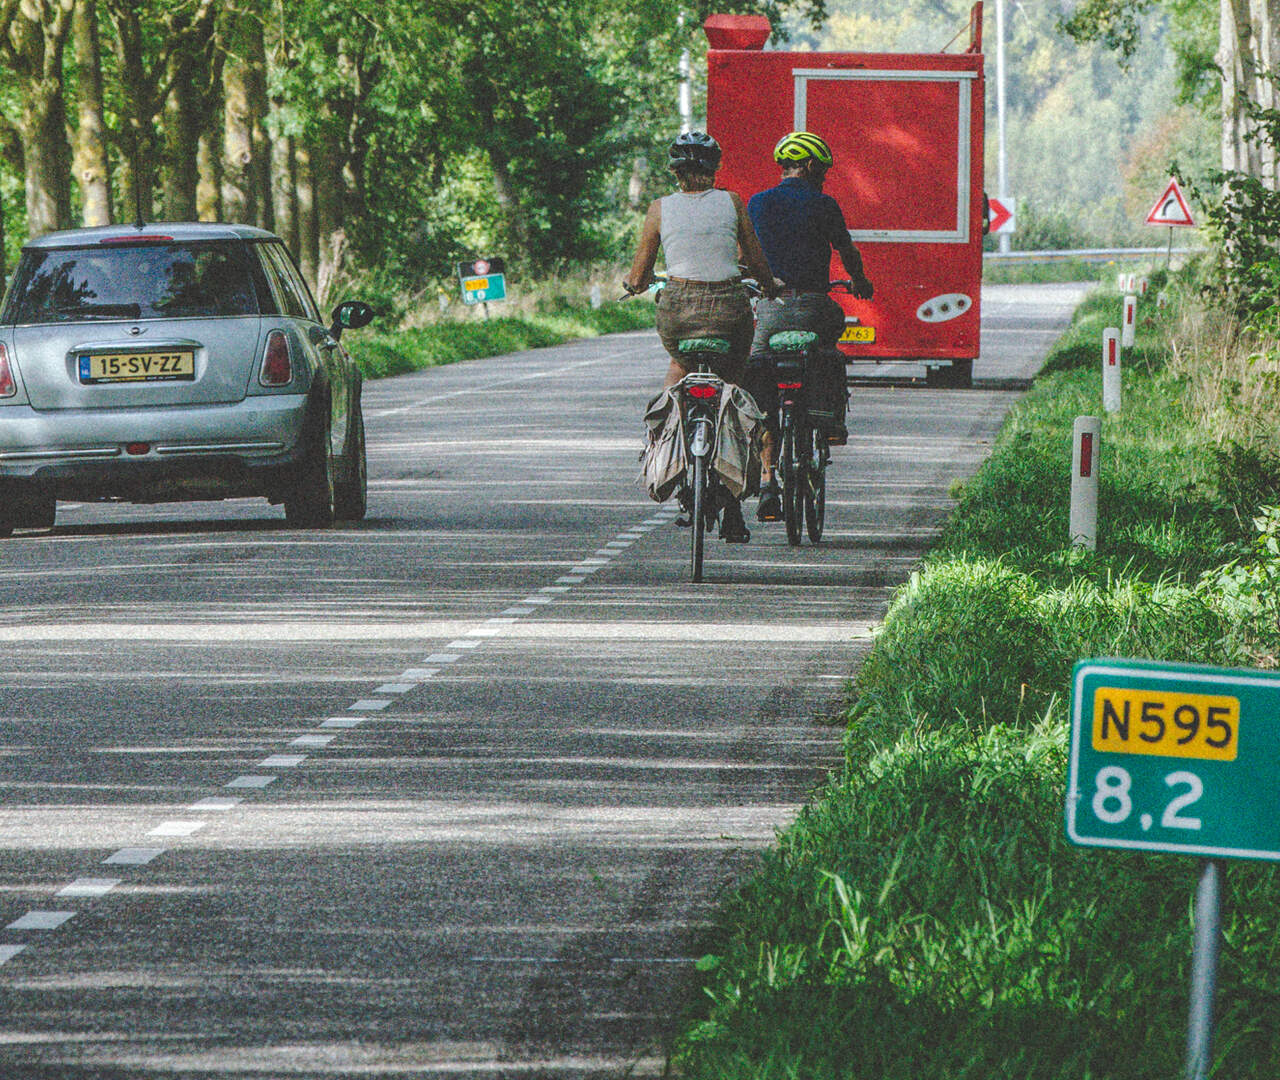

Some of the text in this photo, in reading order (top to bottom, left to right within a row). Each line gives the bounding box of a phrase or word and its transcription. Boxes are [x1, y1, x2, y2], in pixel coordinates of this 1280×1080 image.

[101, 355, 182, 375] 15-SV-ZZ
[1101, 699, 1232, 748] N595
[1092, 765, 1204, 831] 8,2
